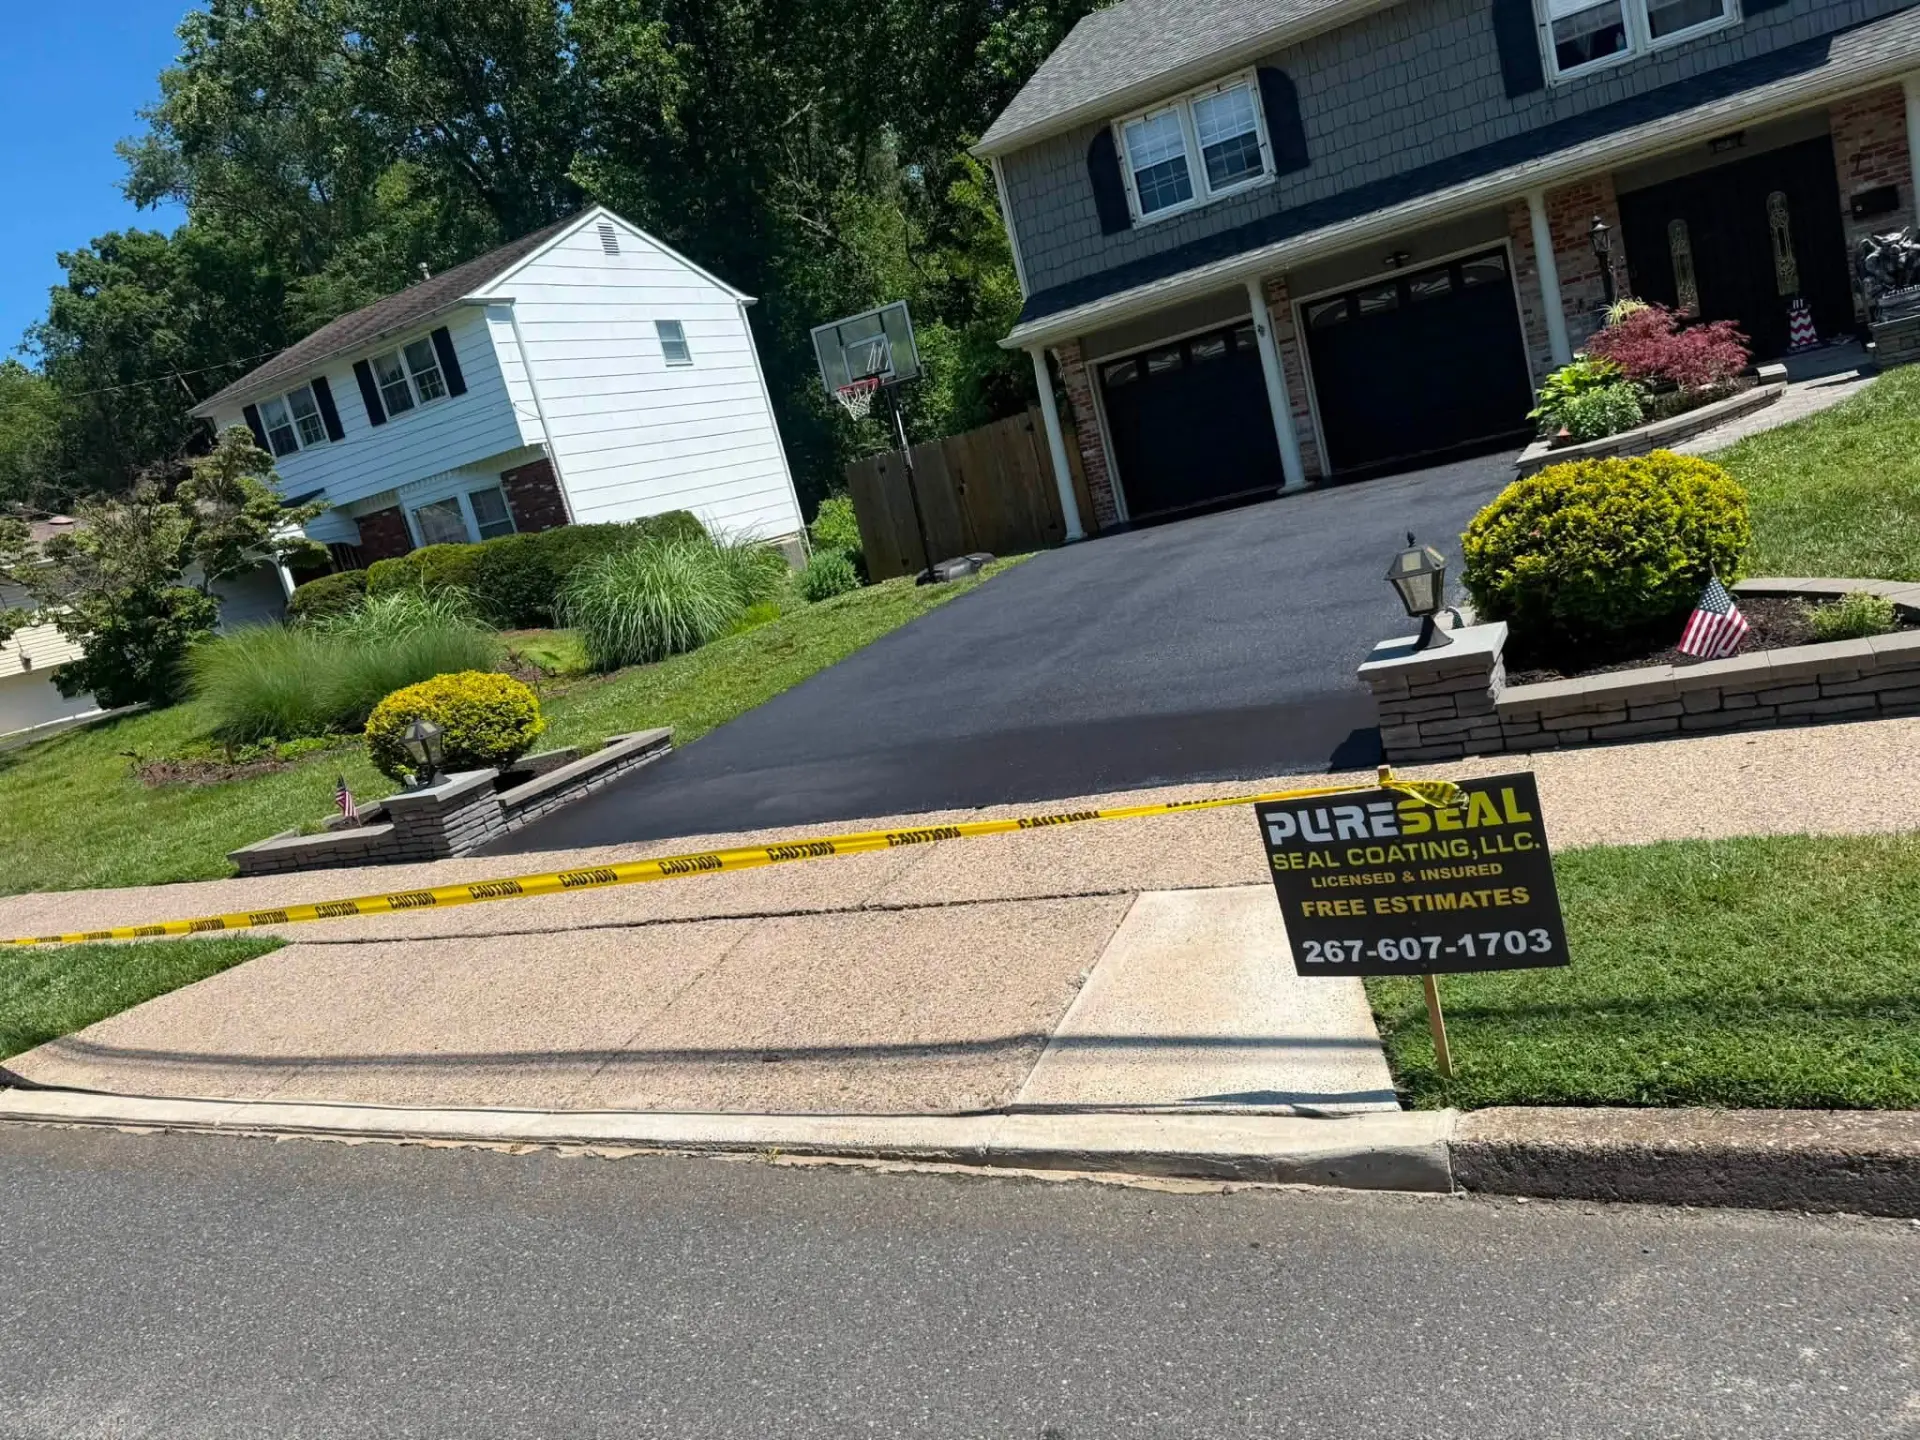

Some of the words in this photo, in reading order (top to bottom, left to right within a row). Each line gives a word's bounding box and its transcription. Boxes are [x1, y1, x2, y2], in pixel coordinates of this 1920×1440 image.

[1272, 852, 1340, 871] SEAL
[1311, 871, 1395, 888] LICENSED
[1402, 870, 1415, 882] &
[1420, 863, 1503, 881] INSURED
[189, 917, 225, 933] CAUTION
[249, 909, 289, 926] CAUTION
[314, 901, 360, 918] CAUTION
[387, 892, 437, 910] CAUTION
[468, 880, 523, 900] CAUTION
[558, 869, 618, 889] CAUTION
[658, 855, 723, 876] CAUTION
[766, 840, 836, 862] CAUTION
[885, 826, 962, 847] CAUTION
[1301, 900, 1367, 917] FREE
[1374, 887, 1530, 915] ESTIMATES
[1302, 928, 1552, 963] 267-607-1703
